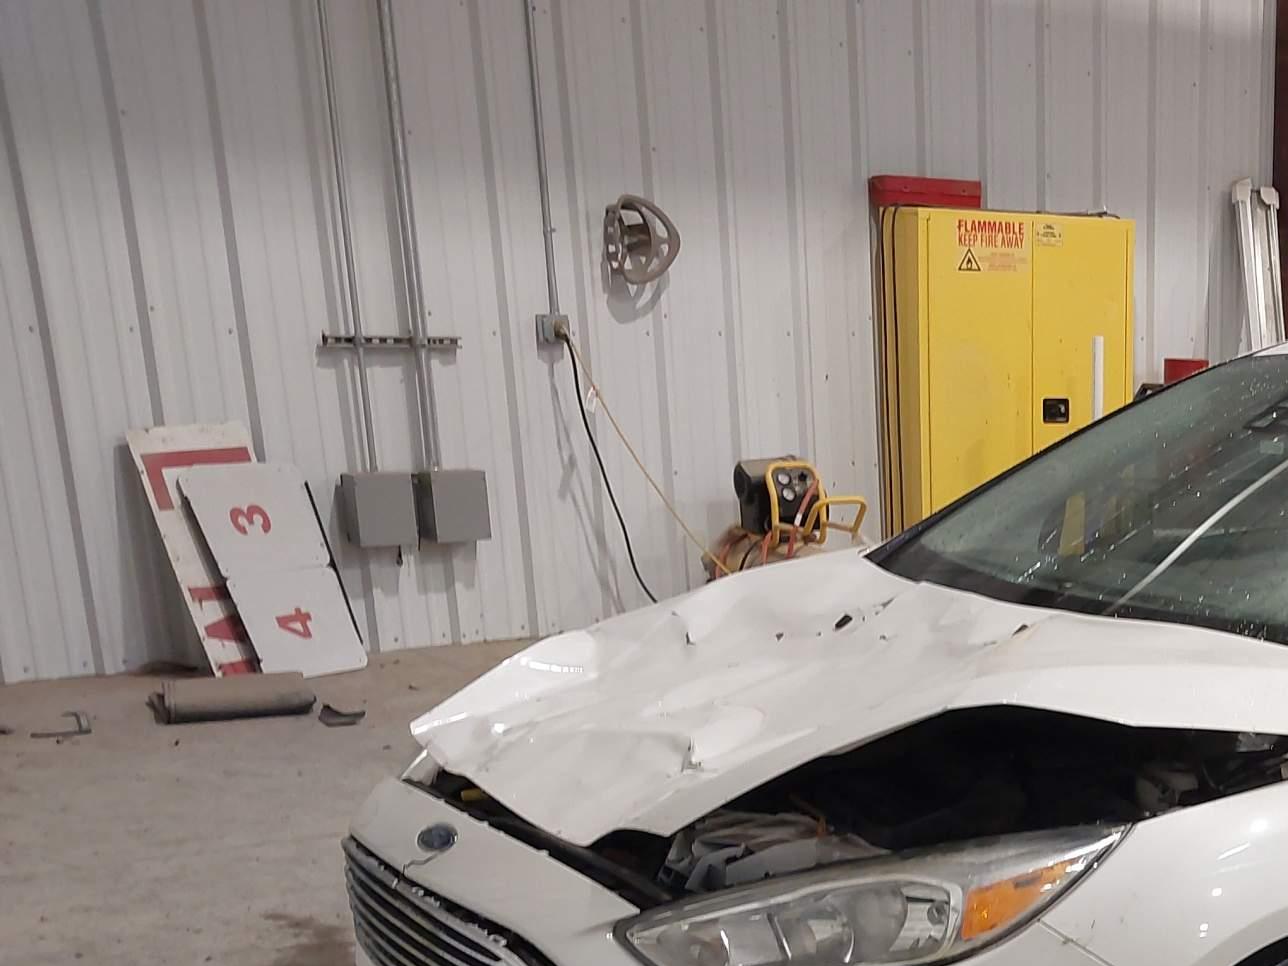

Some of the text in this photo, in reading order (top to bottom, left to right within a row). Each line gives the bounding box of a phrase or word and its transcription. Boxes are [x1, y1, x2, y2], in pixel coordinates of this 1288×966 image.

[957, 219, 1025, 236] FLAMMABLE
[958, 232, 978, 247] KEEP
[980, 233, 999, 248] FIRE
[1000, 234, 1024, 249] AWAY
[229, 504, 272, 536] 3
[275, 607, 313, 640] 4
